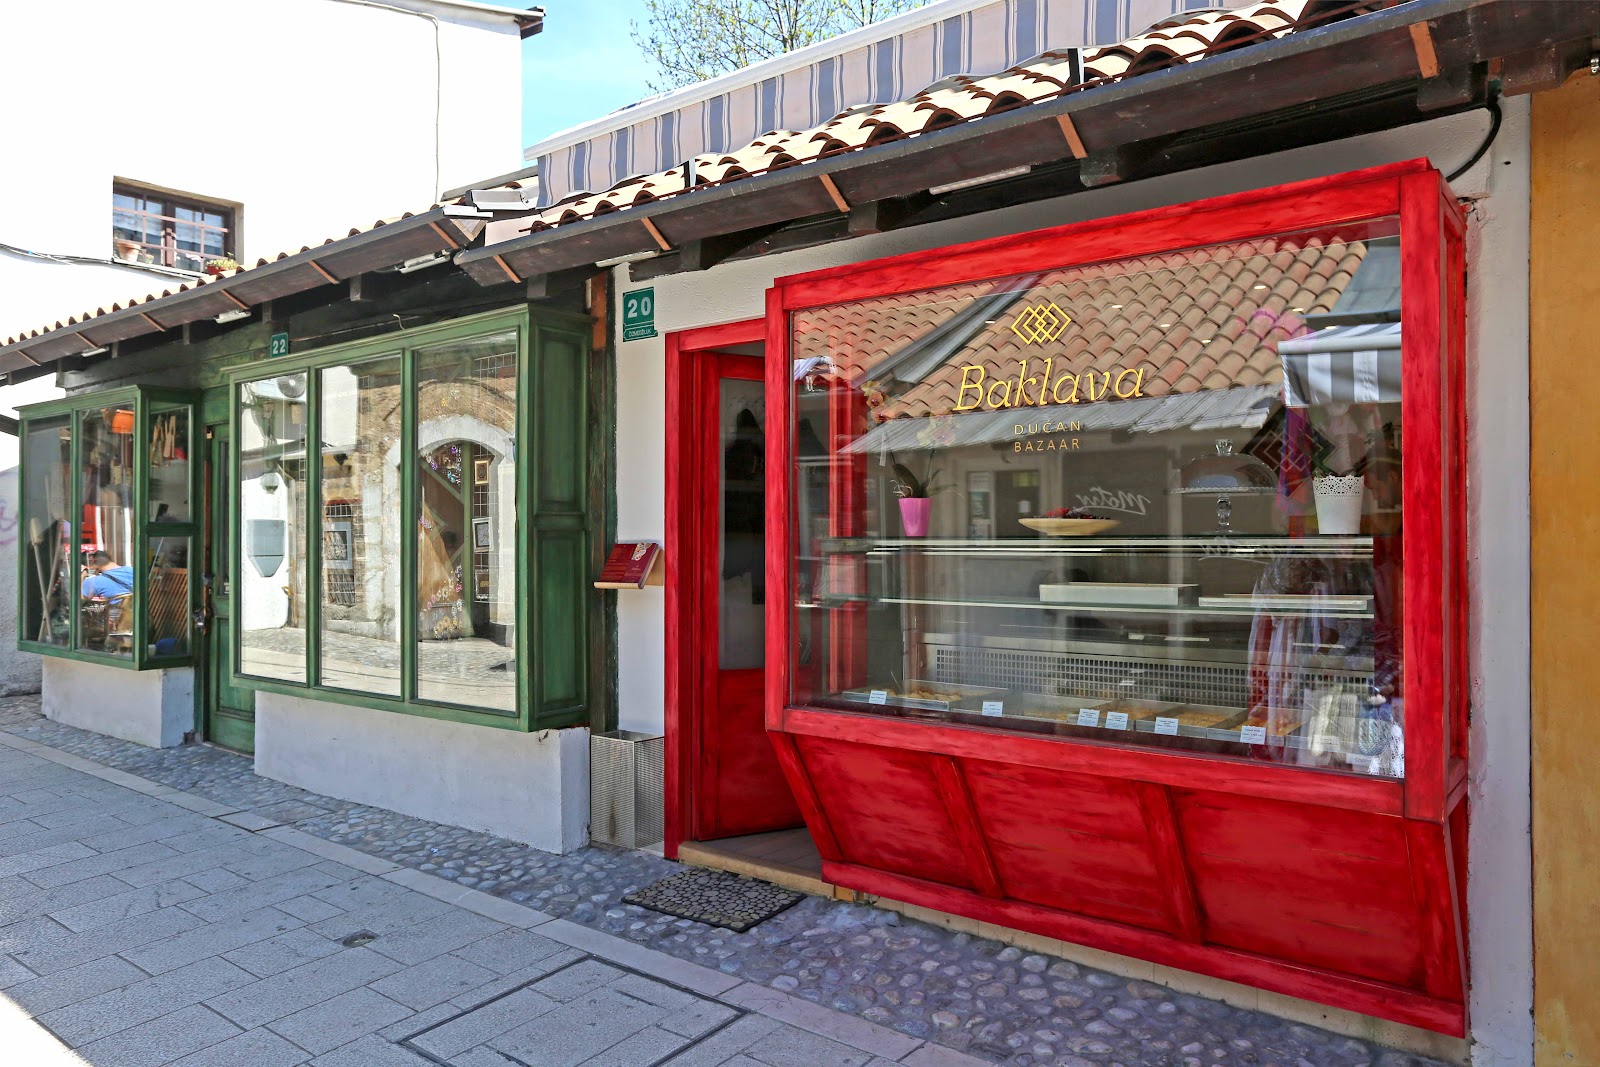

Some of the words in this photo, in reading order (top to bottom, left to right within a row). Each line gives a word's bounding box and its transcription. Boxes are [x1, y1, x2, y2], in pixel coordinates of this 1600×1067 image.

[627, 297, 651, 318] 20
[272, 339, 286, 355] 22
[952, 357, 1145, 411] Baklava
[1014, 419, 1081, 435] DUĆAN
[1014, 438, 1080, 453] BAZAAR
